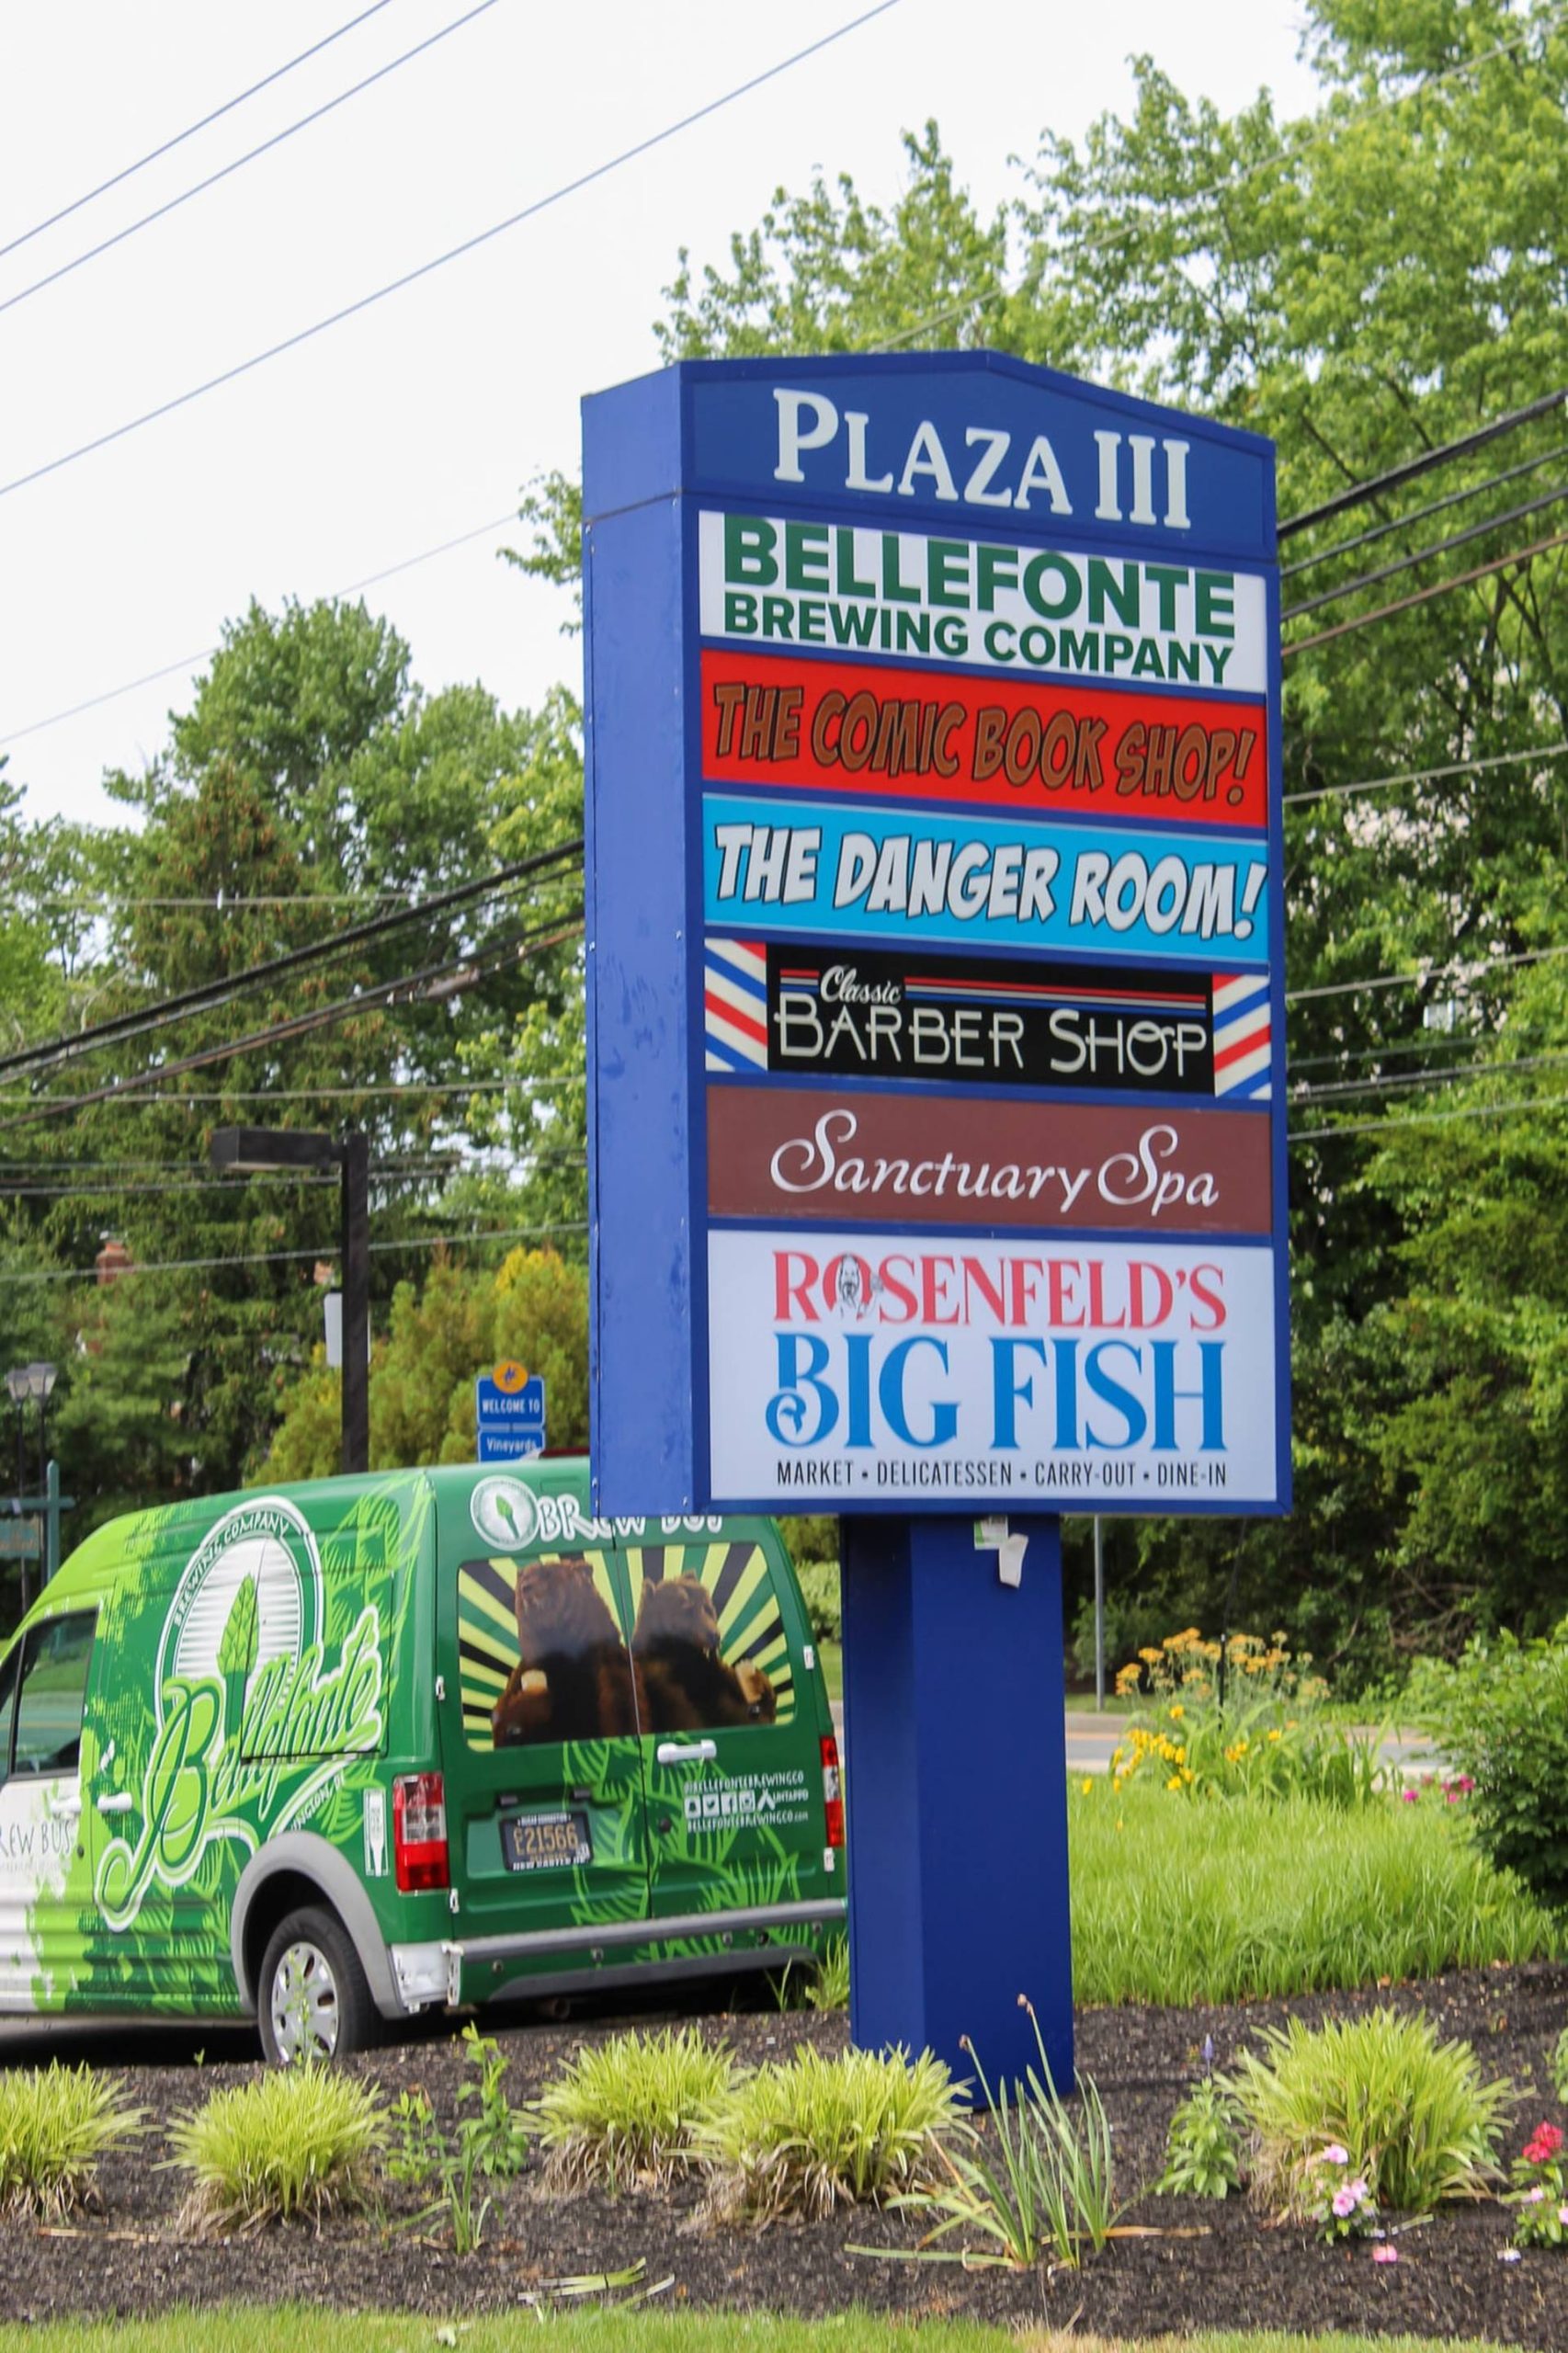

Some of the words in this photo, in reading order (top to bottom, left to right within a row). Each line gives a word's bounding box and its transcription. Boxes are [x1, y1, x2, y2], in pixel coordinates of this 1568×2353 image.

[774, 388, 1074, 515] PLAZA
[1094, 430, 1191, 529] III
[723, 514, 1235, 640] BELLEFONTE
[724, 592, 968, 657] BREWING
[984, 621, 1233, 685] COMPANY
[713, 682, 804, 760] THE
[812, 689, 967, 779] COMIC
[971, 708, 1108, 791] BOOK
[1115, 722, 1256, 805] SHOP!
[714, 824, 823, 907] THE
[834, 832, 1060, 923] DANGER
[1069, 851, 1267, 940] ROOM!
[819, 964, 902, 1006] Classic
[773, 991, 1025, 1069] BARBER
[1049, 1008, 1208, 1077] SHOP
[770, 1108, 1092, 1213] Sanctuary
[1097, 1124, 1220, 1217] Spa
[772, 1250, 1228, 1331] ROSENFELD'S
[482, 1398, 526, 1415] WELCOME
[528, 1398, 540, 1415] TO
[765, 1331, 960, 1449] BIG
[989, 1336, 1228, 1451] FISH
[777, 1460, 854, 1486] MARKET
[876, 1460, 1012, 1487] DELICATESSEN
[1035, 1460, 1136, 1487] CARRY-OUT
[1157, 1460, 1227, 1487] DINE-IN
[223, 1510, 290, 1544] COMPANY
[40, 1819, 71, 1854] BUS
